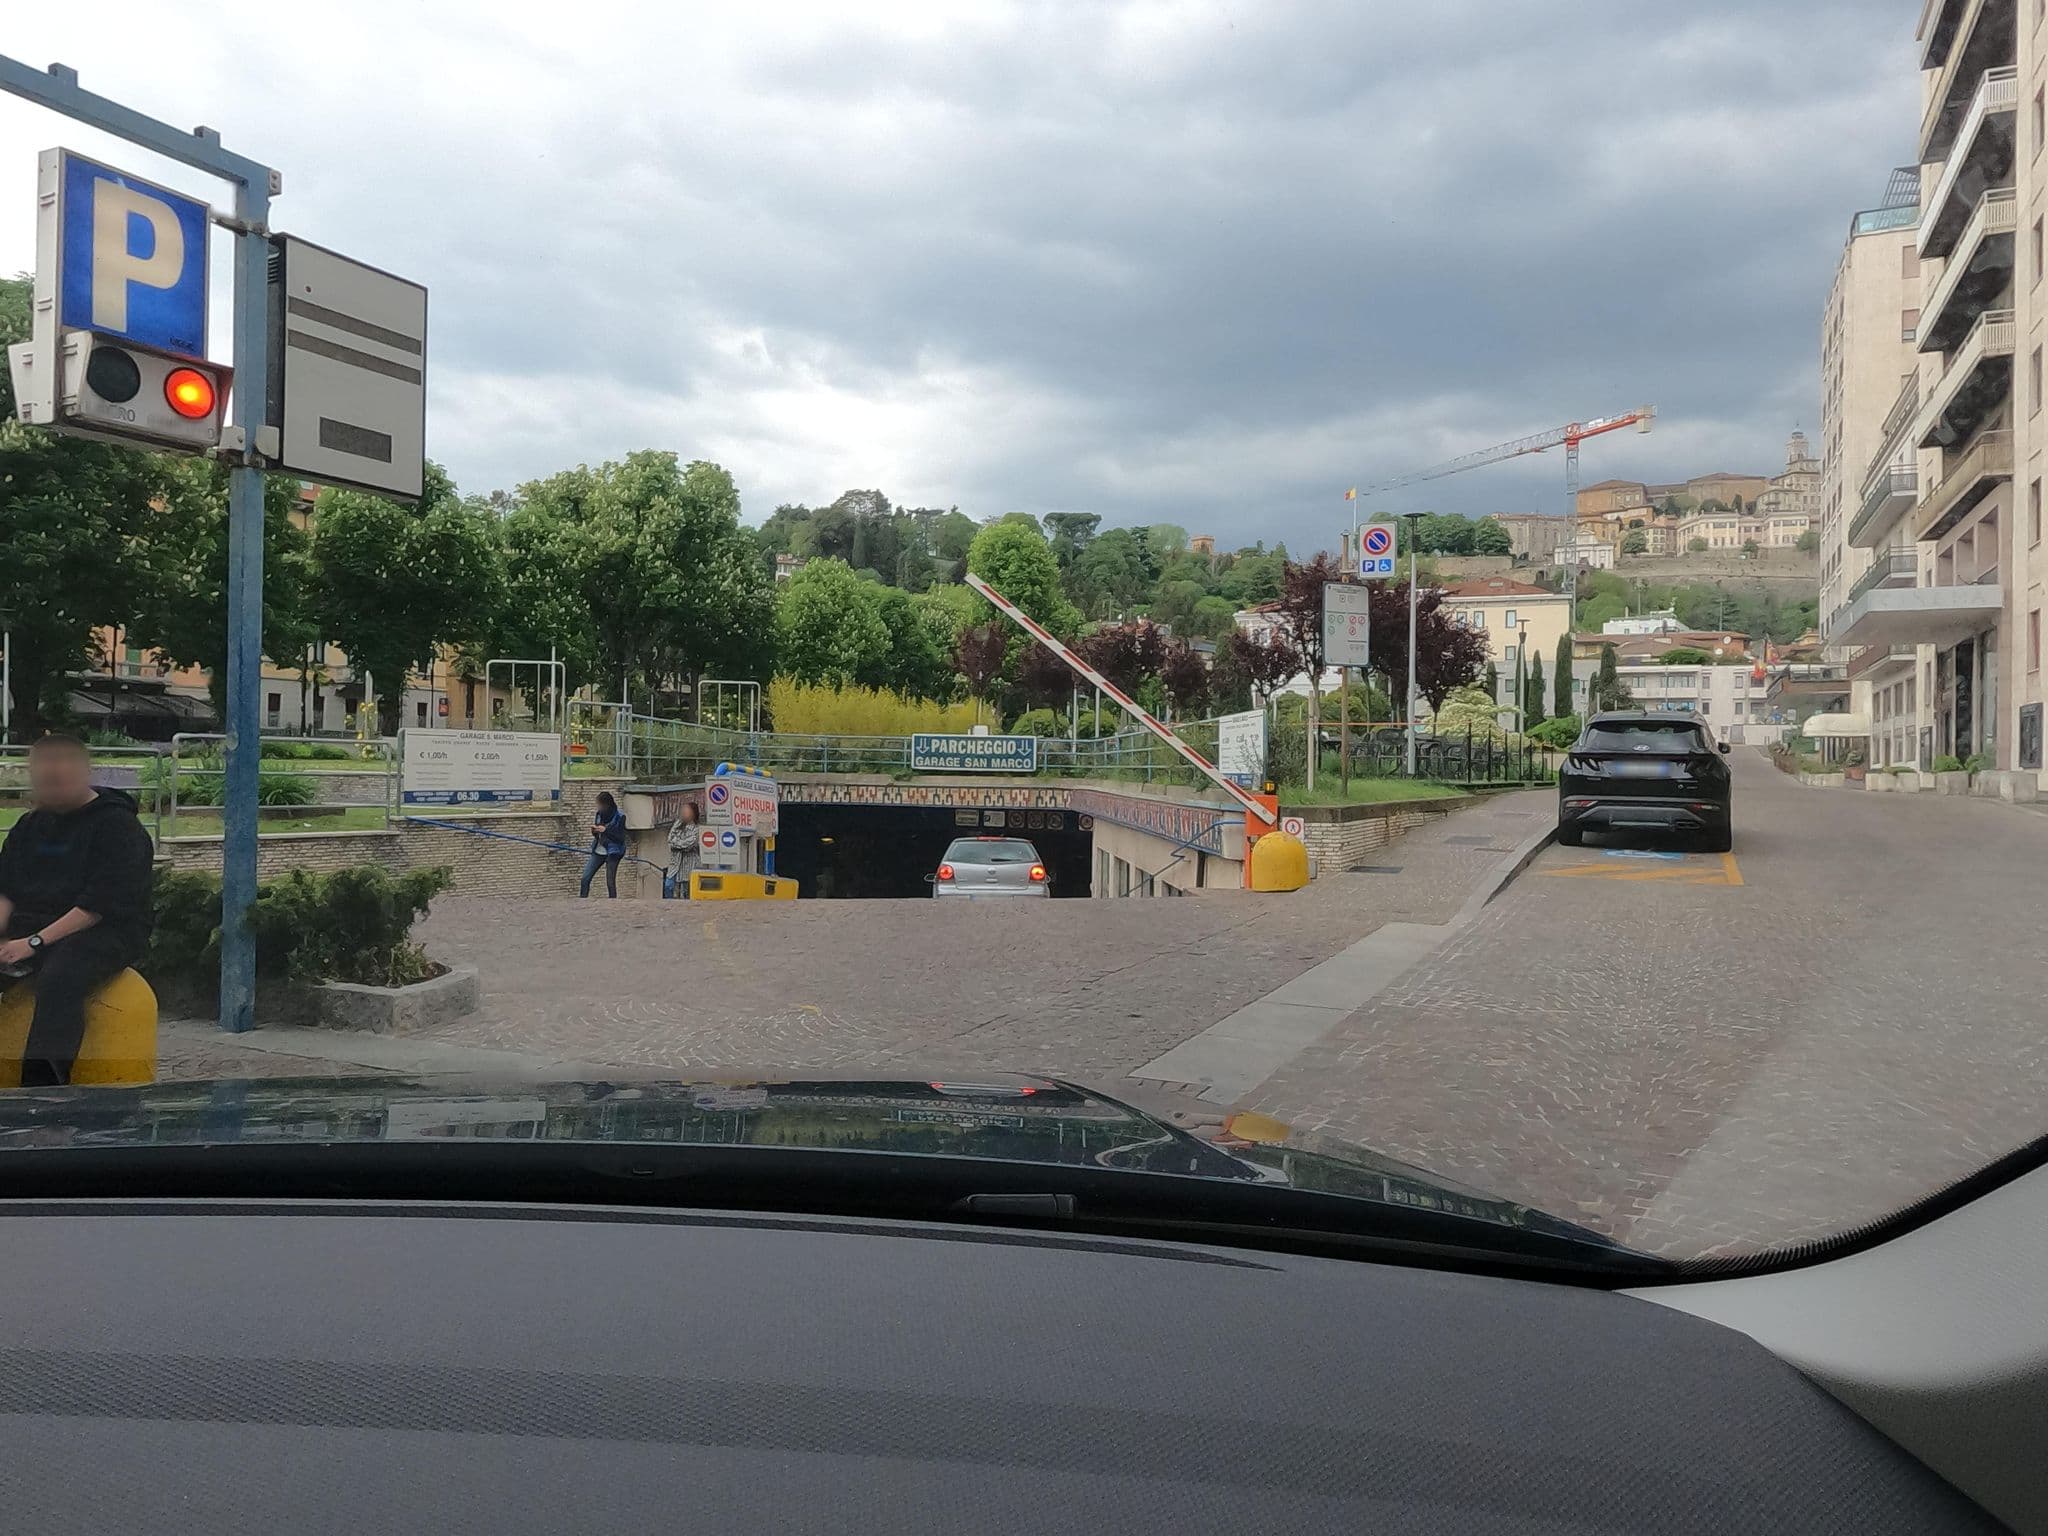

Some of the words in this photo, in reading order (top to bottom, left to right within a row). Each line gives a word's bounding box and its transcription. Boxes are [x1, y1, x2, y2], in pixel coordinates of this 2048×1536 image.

[92, 176, 185, 333] P
[1365, 561, 1374, 572] P
[459, 732, 486, 740] GARAGE
[930, 738, 1017, 755] PARCHEGGIO
[915, 756, 961, 767] GARAGE
[964, 758, 988, 768] SAN
[991, 758, 1032, 769] MARCO
[457, 791, 480, 801] 06.30
[734, 796, 776, 812] CHIUSURA
[734, 812, 752, 827] ORE
